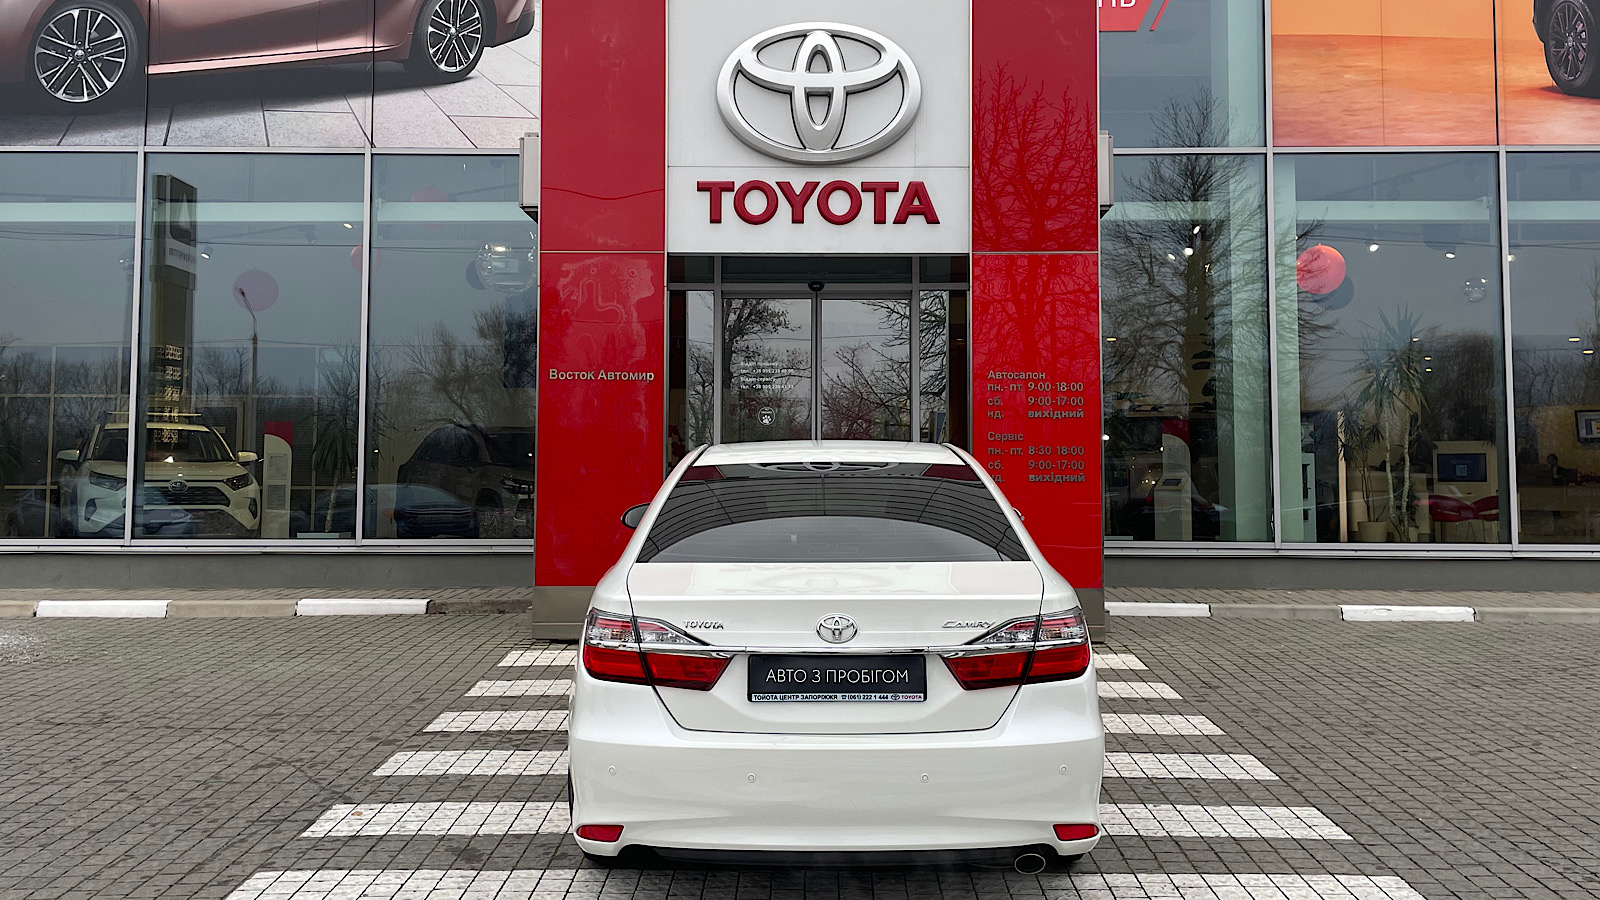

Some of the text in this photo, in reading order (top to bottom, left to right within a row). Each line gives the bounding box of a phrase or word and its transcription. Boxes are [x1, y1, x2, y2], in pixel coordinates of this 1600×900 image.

[696, 179, 940, 225] TOYOTA
[549, 368, 655, 383] Восток Автомир
[987, 369, 1046, 380] Автосалон
[987, 396, 1084, 406] сб. 9:00-17:00
[987, 408, 1084, 420] нд. вихідний
[987, 431, 1024, 443] Сервіс
[987, 460, 1085, 470] сб. 9:00-17:00
[1028, 471, 1086, 483] вихідний
[683, 619, 725, 630] TOYOTA
[765, 668, 909, 684] АВТО З ПРОБІГОМ
